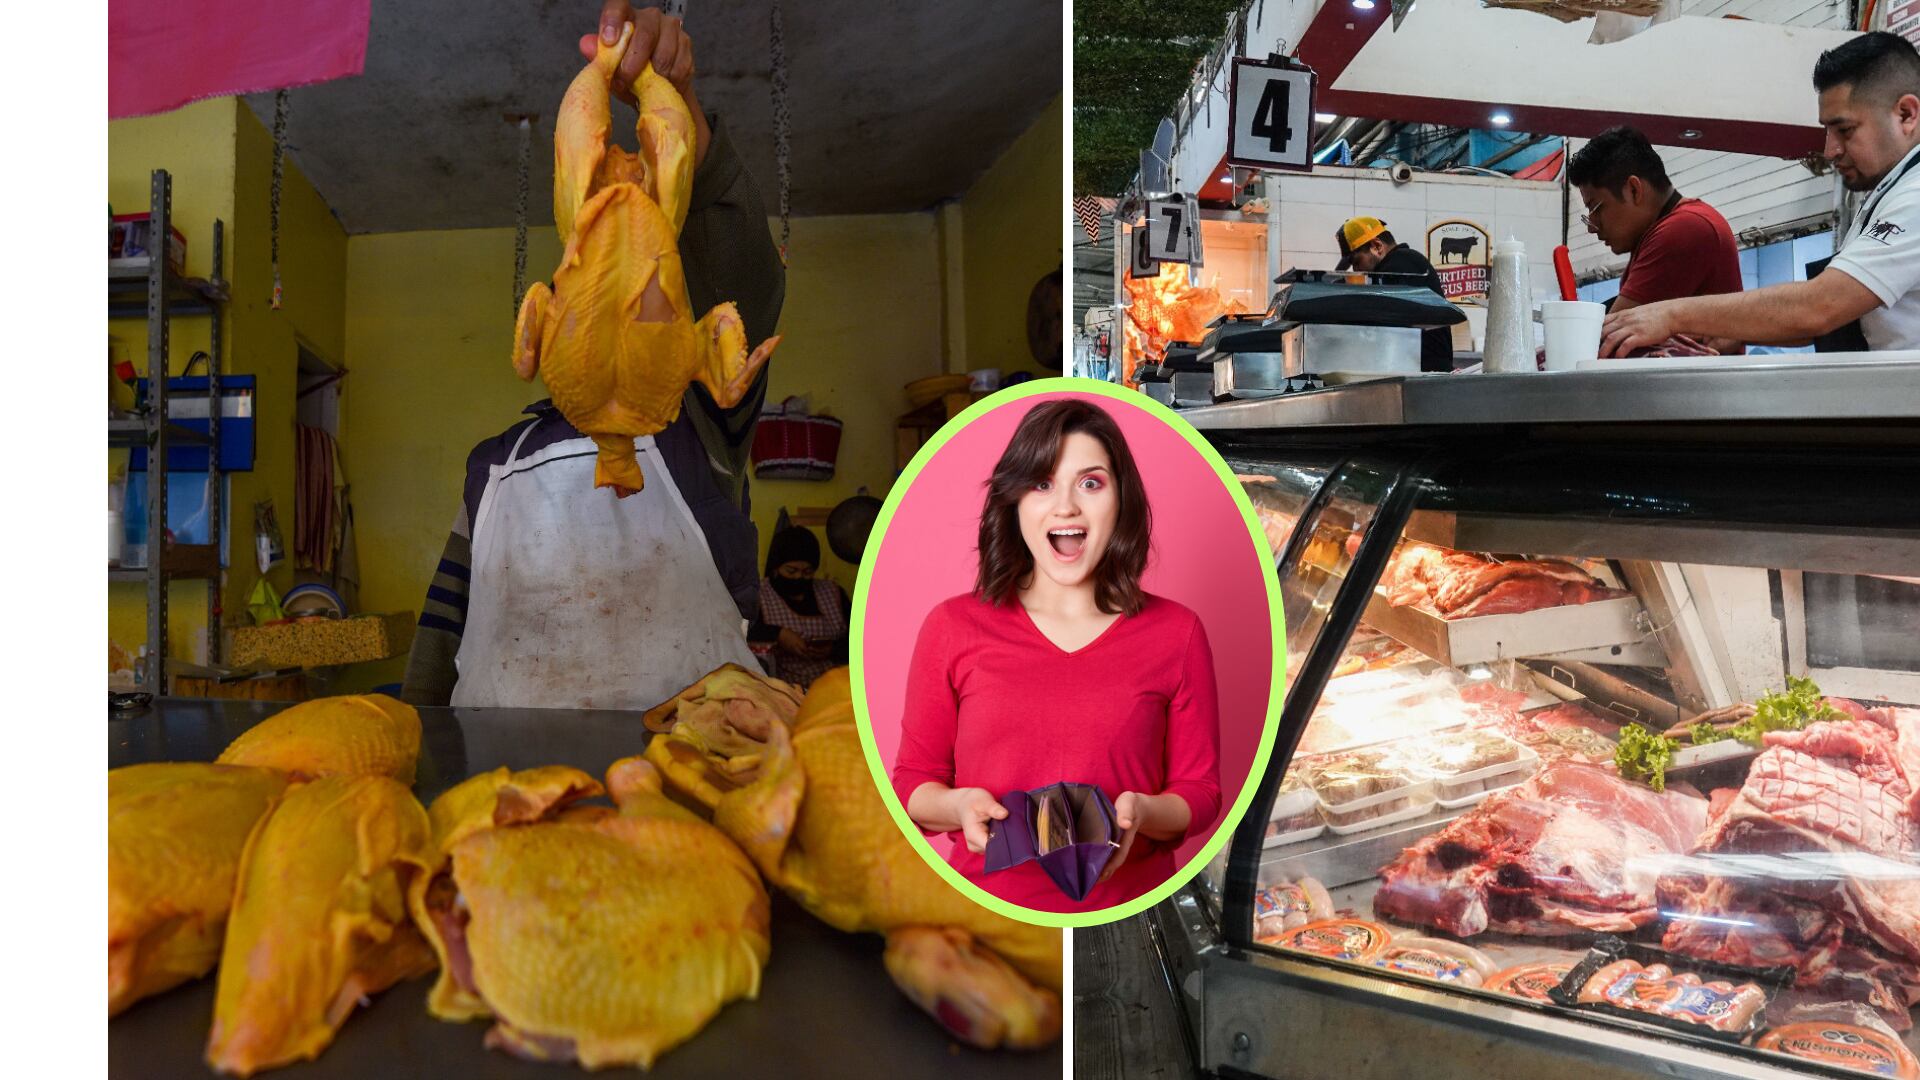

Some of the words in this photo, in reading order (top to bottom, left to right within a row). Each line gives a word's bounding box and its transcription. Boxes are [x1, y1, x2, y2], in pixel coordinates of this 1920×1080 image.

[1251, 79, 1293, 154] 4
[1161, 207, 1182, 253] 7
[1437, 268, 1486, 282] RTIFIED
[1440, 282, 1463, 295] GUS
[1464, 280, 1491, 292] BEEF
